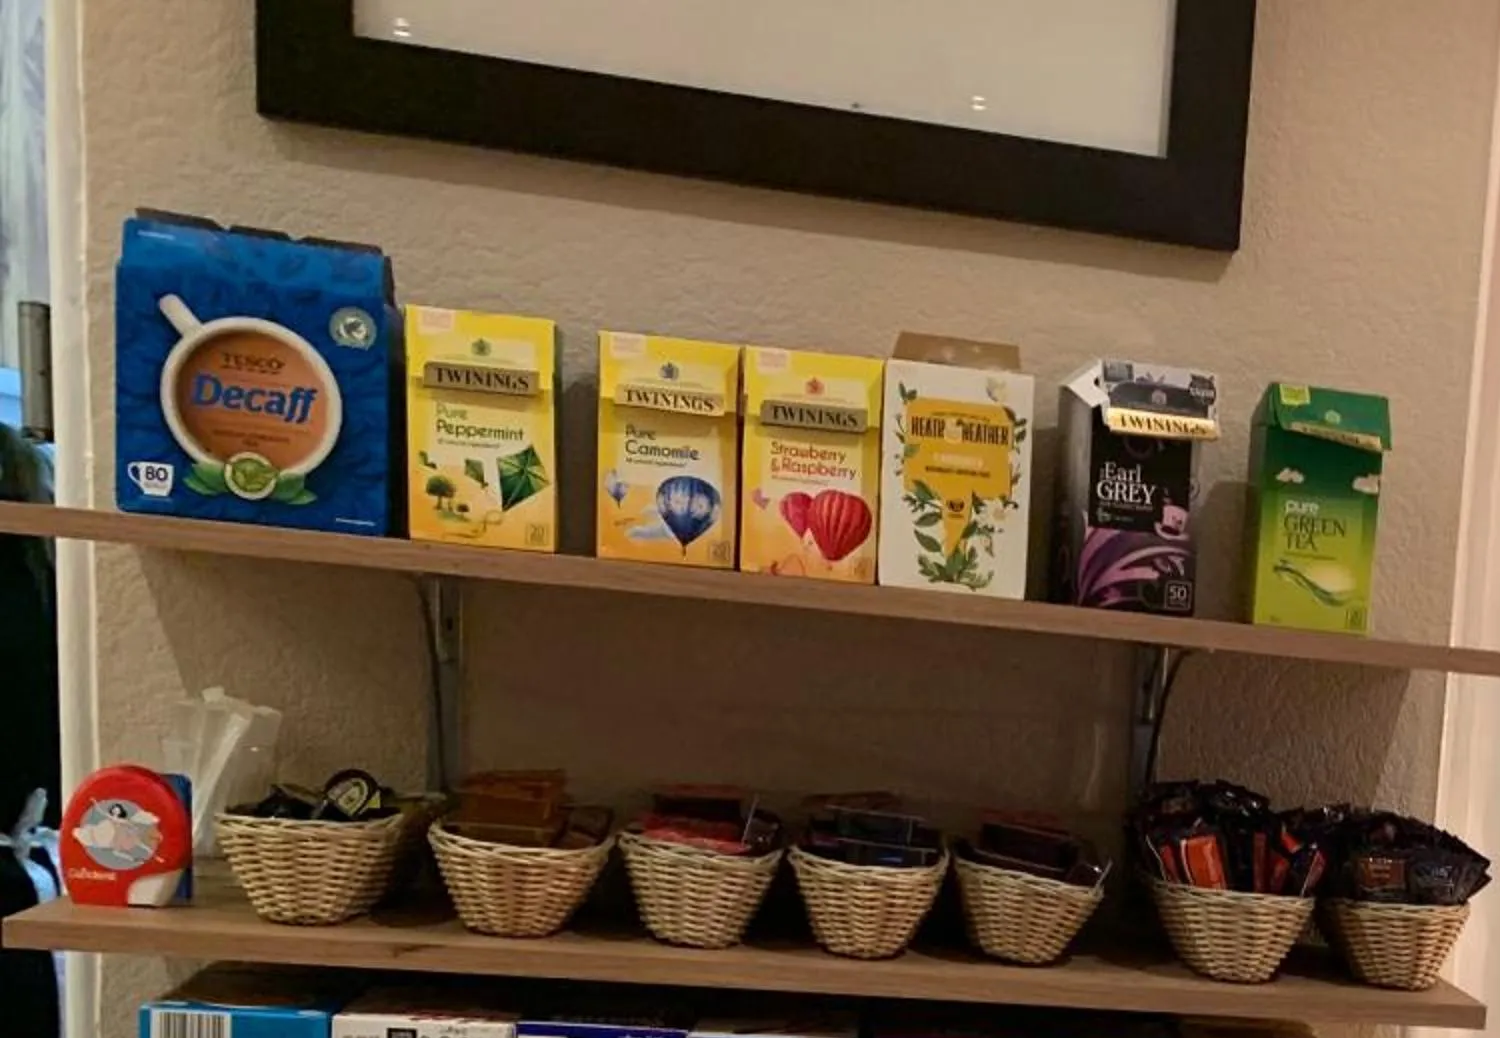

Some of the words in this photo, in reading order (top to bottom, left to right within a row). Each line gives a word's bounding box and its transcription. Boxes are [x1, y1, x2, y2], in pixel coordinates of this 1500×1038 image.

[222, 352, 286, 371] TESCO
[436, 367, 529, 390] TWININGS
[192, 372, 318, 424] Decaff
[624, 387, 715, 412] TWININGS
[436, 401, 468, 420] Pure
[772, 405, 858, 428] TWININGS
[436, 418, 524, 441] Peppermint
[1120, 414, 1208, 435] TWININGS
[624, 439, 702, 461] Camomile
[770, 441, 847, 464] Strawberry
[145, 465, 168, 481] 80
[782, 457, 857, 480] Raspberry
[1104, 460, 1142, 483] Earl
[1096, 480, 1157, 505] GREY
[1283, 513, 1345, 537] GREEN
[1284, 532, 1318, 552] TEA
[1168, 584, 1187, 600] 50
